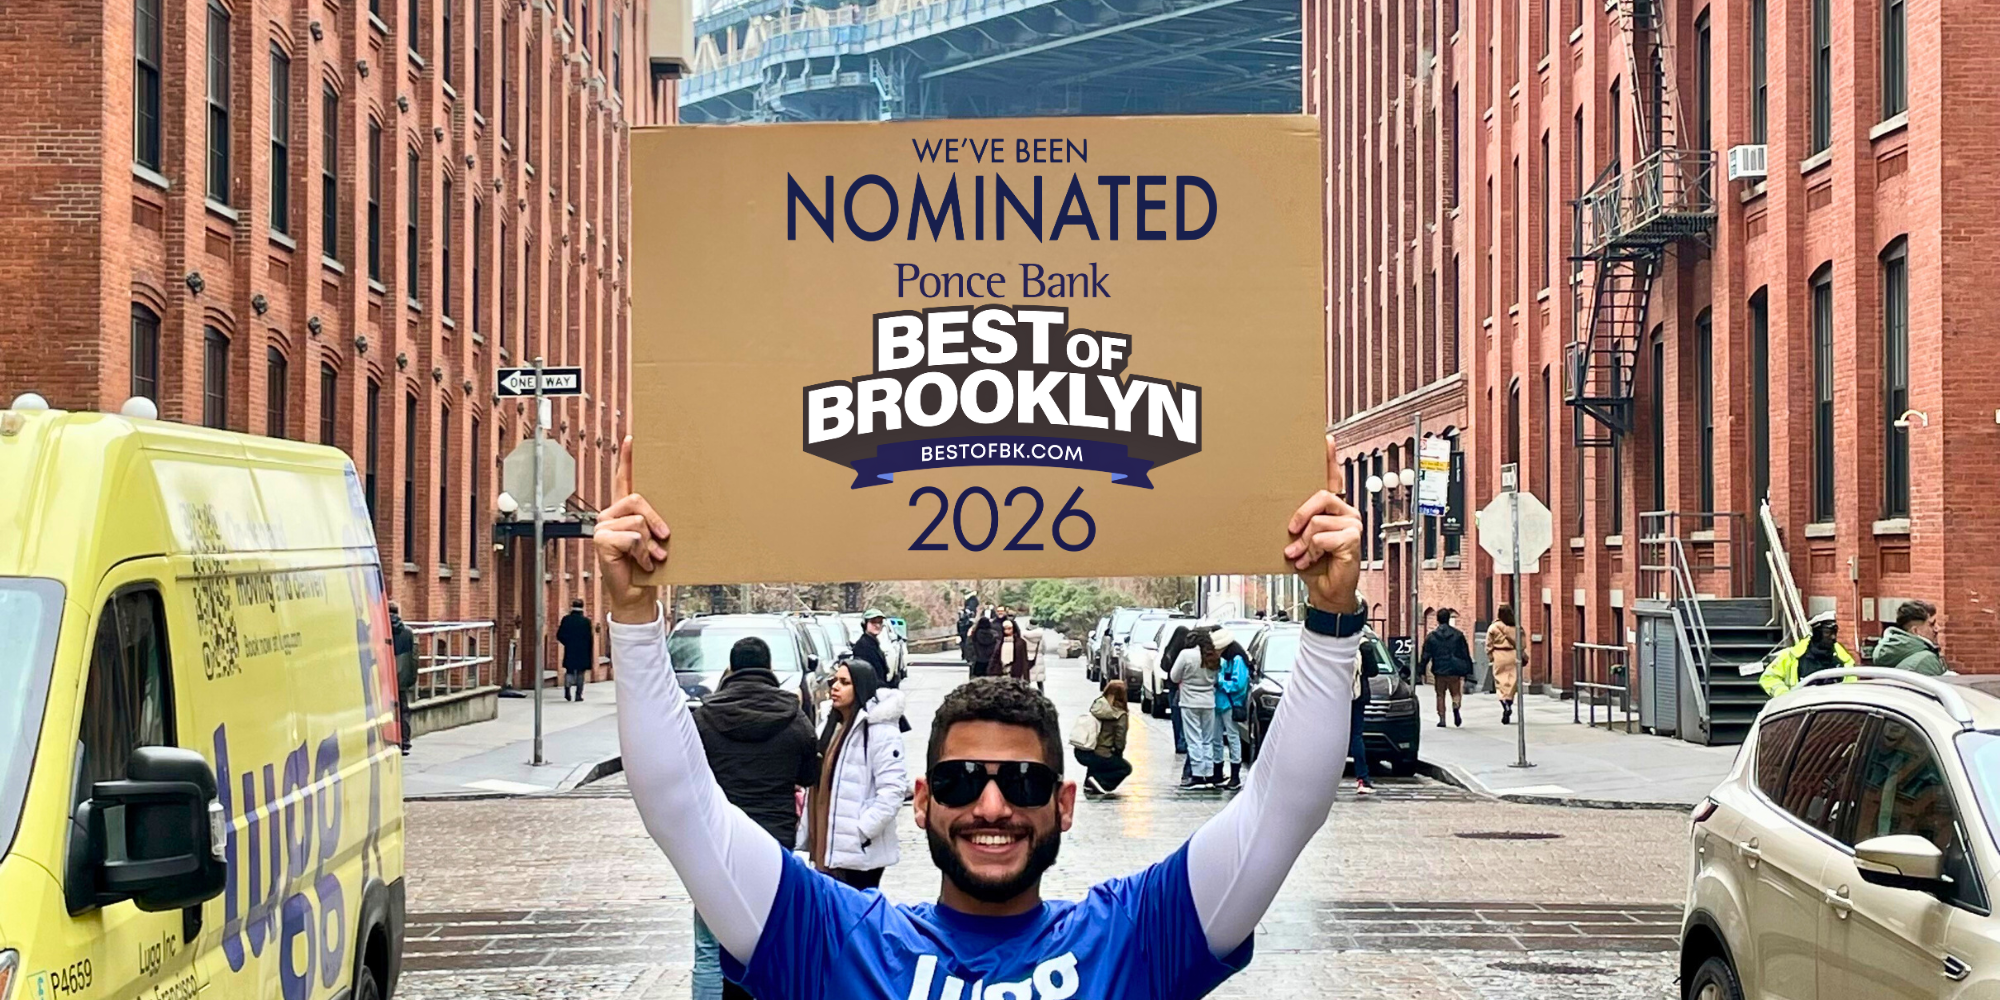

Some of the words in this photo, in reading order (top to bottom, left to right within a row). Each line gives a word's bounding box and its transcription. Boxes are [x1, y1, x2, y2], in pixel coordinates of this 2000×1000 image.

[911, 137, 1005, 164] WE'VE
[1016, 137, 1088, 163] BEEN
[786, 171, 1218, 244] NOMINATED
[894, 263, 1006, 298] Ponce
[1019, 262, 1111, 298] Bank
[877, 307, 1065, 372] BEST
[1066, 333, 1128, 371] OF
[510, 377, 535, 388] ONE
[545, 376, 571, 386] WAY
[807, 367, 1198, 445] BROOKLYN
[920, 443, 1084, 462] BESTOFBK.COM
[906, 486, 1097, 552] 2026
[213, 722, 345, 1000] lugg
[139, 942, 161, 977] Lugg
[162, 930, 177, 963] Inc
[51, 958, 92, 1000] P4659
